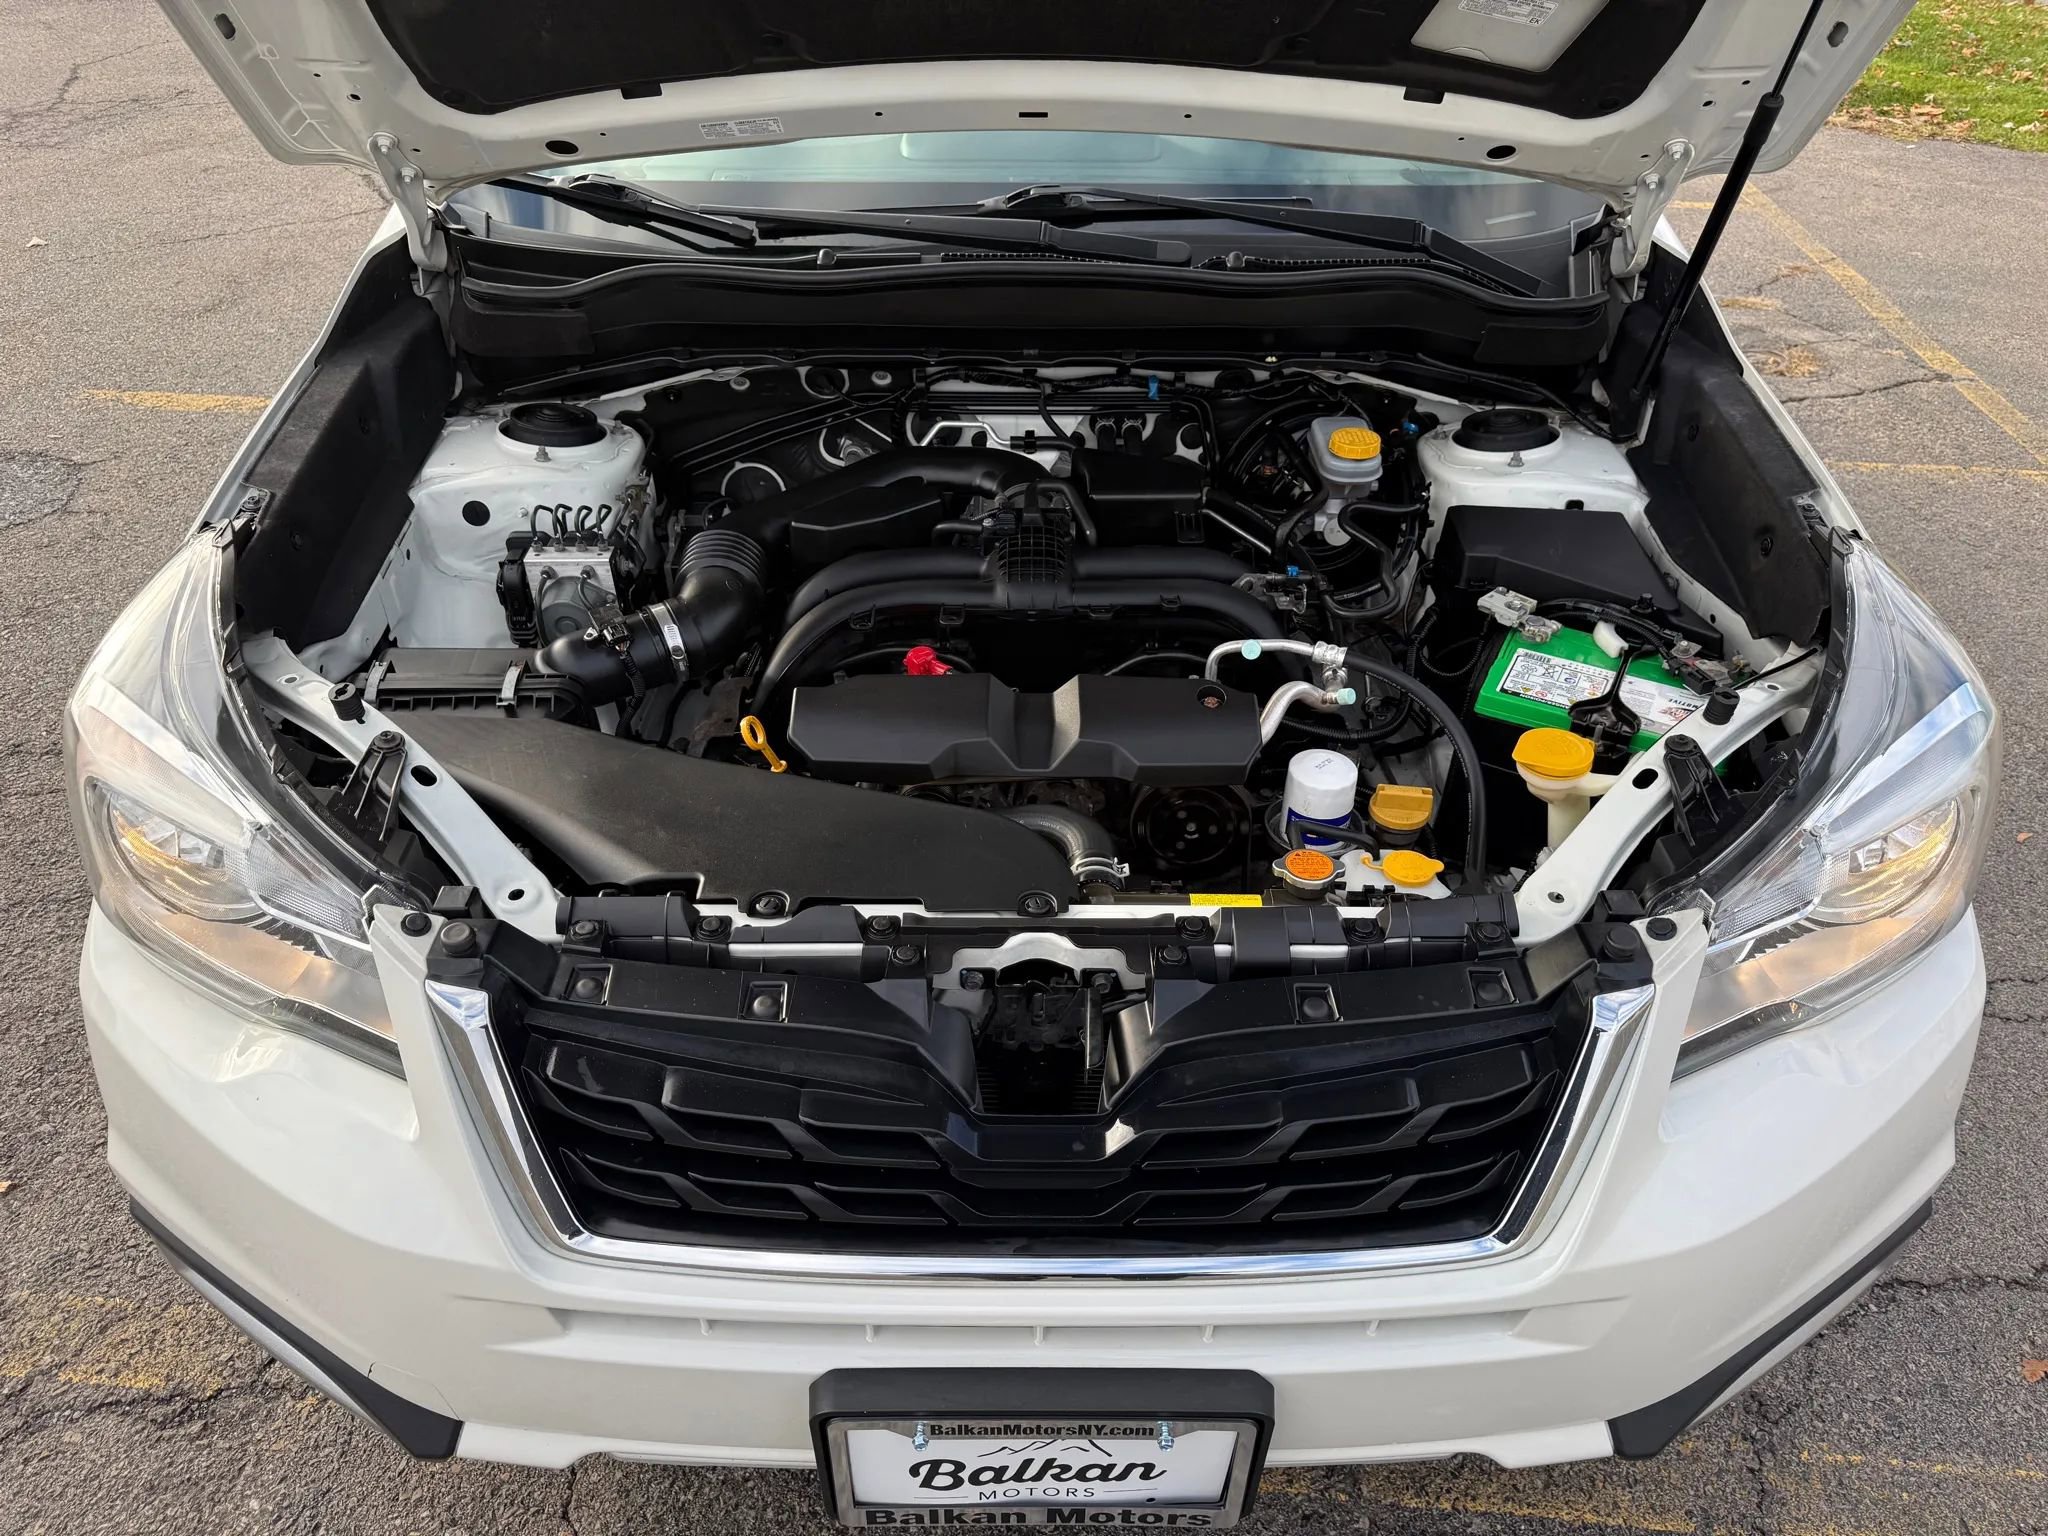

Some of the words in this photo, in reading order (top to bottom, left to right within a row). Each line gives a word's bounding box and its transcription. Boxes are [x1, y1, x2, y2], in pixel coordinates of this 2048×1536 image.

[930, 1424, 1155, 1437] BalkanMotorsNY.com
[909, 1457, 1168, 1490] Balkan
[978, 1487, 1095, 1501] MOTORS
[865, 1508, 1028, 1526] Balkan
[1046, 1508, 1212, 1526] Motors
